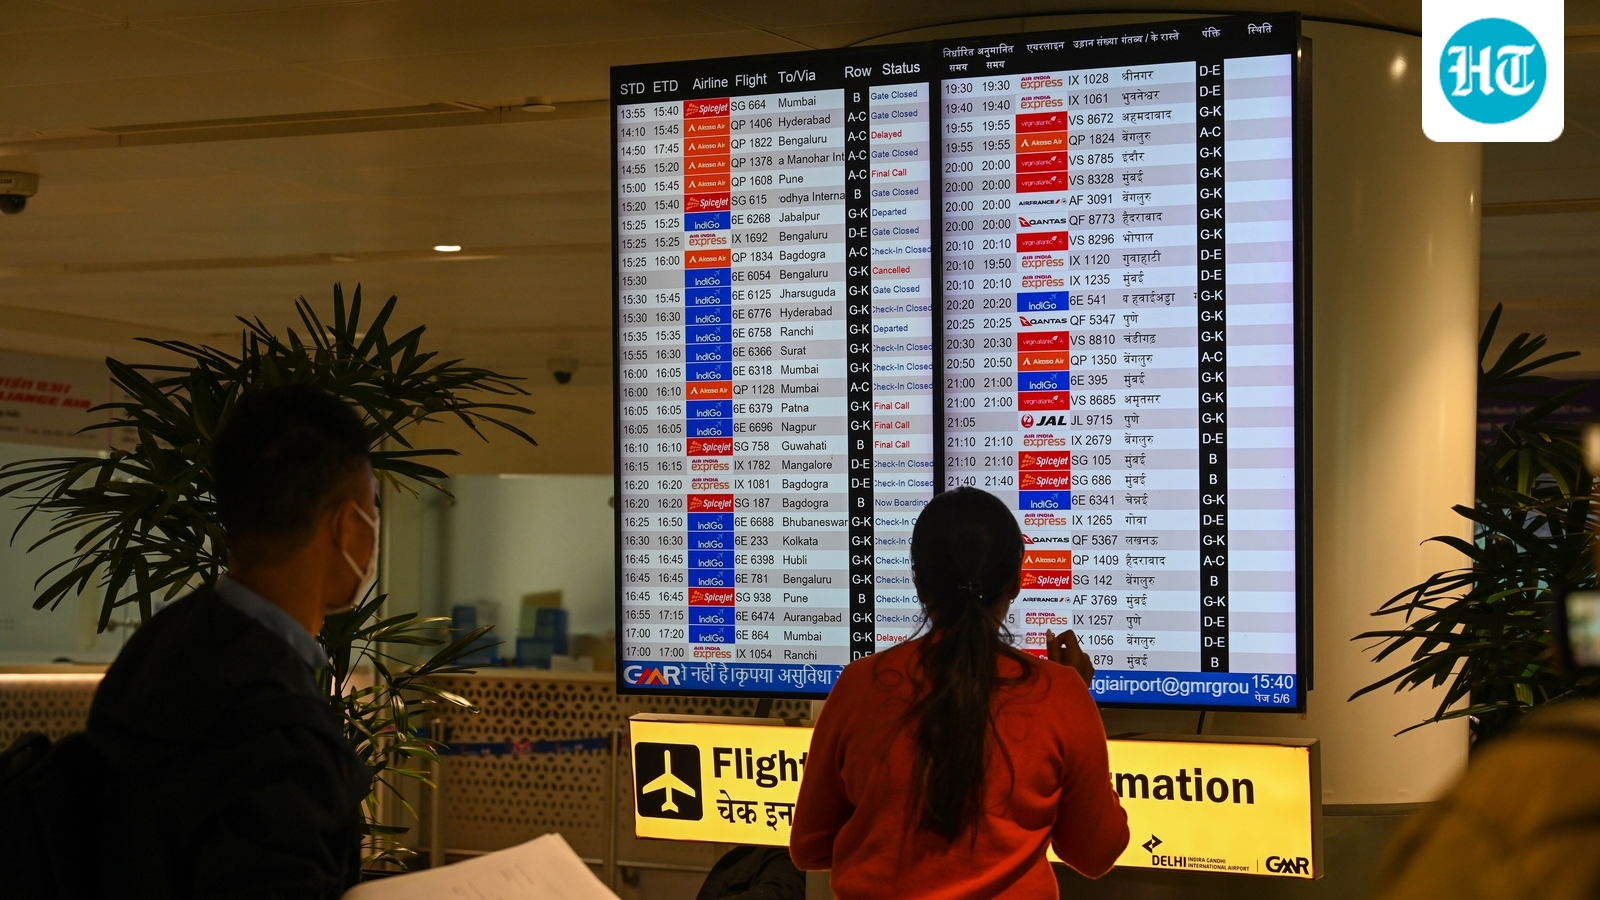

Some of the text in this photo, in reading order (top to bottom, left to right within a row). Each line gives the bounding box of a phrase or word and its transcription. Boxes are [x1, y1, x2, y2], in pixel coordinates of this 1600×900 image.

[977, 43, 1014, 57] अनुमानित
[1027, 42, 1065, 53] एयरलाइन
[1073, 39, 1094, 49] उड़ान
[1096, 36, 1118, 46] संख्या
[1121, 34, 1143, 44] गंतव्य
[1248, 23, 1272, 34] स्थिति
[949, 61, 1005, 72] समय समय
[620, 62, 921, 95] STD ETD Airline Flight To/Via Row Status
[946, 83, 972, 94] 19:30
[983, 80, 1010, 91] 19:30
[1020, 78, 1063, 90] express
[1069, 75, 1079, 86] IX
[1084, 73, 1109, 84] 1028
[1122, 69, 1154, 81] श्रीनगर
[1200, 65, 1220, 76] D-E
[621, 108, 645, 119] 13:55
[654, 106, 679, 116] 15:40
[731, 101, 746, 111] SG
[749, 100, 766, 110] 664
[779, 96, 816, 108] Mumbai
[854, 92, 860, 102] B
[891, 90, 918, 99] Closed
[621, 146, 645, 156] 14:50
[654, 143, 679, 154] 17:45
[731, 139, 746, 149] QP
[750, 137, 772, 148] 1822
[779, 135, 827, 147] Bengaluru
[848, 131, 866, 141] A-C
[871, 130, 902, 140] Delayed
[946, 142, 973, 153] 19:55
[983, 140, 1010, 151] 19:55
[1069, 135, 1085, 146] QP
[1090, 133, 1115, 144] 1824
[1122, 130, 1151, 145] बेंगलुरु
[1200, 126, 1221, 138] A-C
[622, 208, 907, 230] 15:25 15:25 IndiGo 6E 6268 Jabalpur G-K Departed
[946, 221, 974, 232] 20:00
[983, 219, 1011, 230] 20:00
[1069, 215, 1085, 226] QF
[1089, 214, 1115, 224] 8773
[1122, 211, 1163, 225] हैदराबाद
[1200, 208, 1222, 219] G-K
[622, 239, 646, 249] 15:25
[655, 237, 680, 247] 15:25
[689, 236, 727, 247] express
[732, 234, 741, 244] IX
[745, 233, 767, 243] 1692
[780, 230, 828, 243] Bengaluru
[849, 227, 867, 238] D-E
[622, 266, 910, 286] 15:30 IndiGo 6E 6054 Bengaluru G-K Cancelled
[624, 425, 648, 434] 16:05
[657, 424, 681, 434] 16:05
[696, 428, 722, 436] IndiGo
[734, 423, 746, 432] 6E
[749, 422, 773, 432] 6696
[782, 422, 816, 434] Nagpur
[851, 420, 870, 430] G-K
[947, 412, 1224, 428] 21:05 JAL JL 9715 पुणे G-K
[948, 457, 976, 467] 21:10
[985, 456, 1013, 466] 21:10
[1072, 455, 1088, 466] SG
[1093, 455, 1111, 465] 105
[1125, 453, 1146, 468] मुंबई
[1210, 454, 1217, 464] B
[625, 499, 649, 508] 16:20
[658, 499, 682, 508] 16:20
[735, 498, 749, 508] SG
[754, 498, 770, 508] 187
[783, 498, 828, 510] Bagdogra
[858, 498, 865, 507] B
[895, 498, 928, 507] Boarding
[1073, 595, 1087, 605] AF
[1091, 595, 1117, 605] 3769
[1126, 594, 1147, 609] मुंबई
[1204, 596, 1226, 606] G-K
[626, 628, 908, 642] 17:00 17:20 IndiGo 6E 864 Mumbai G-K Delayed
[691, 662, 716, 683] नहीं
[778, 664, 833, 688] असुविधा
[1252, 675, 1293, 689] 15:40
[1273, 694, 1290, 704] 5/6
[1110, 768, 1254, 804] mation
[716, 790, 758, 824] चेक
[1152, 855, 1186, 868] DELHI
